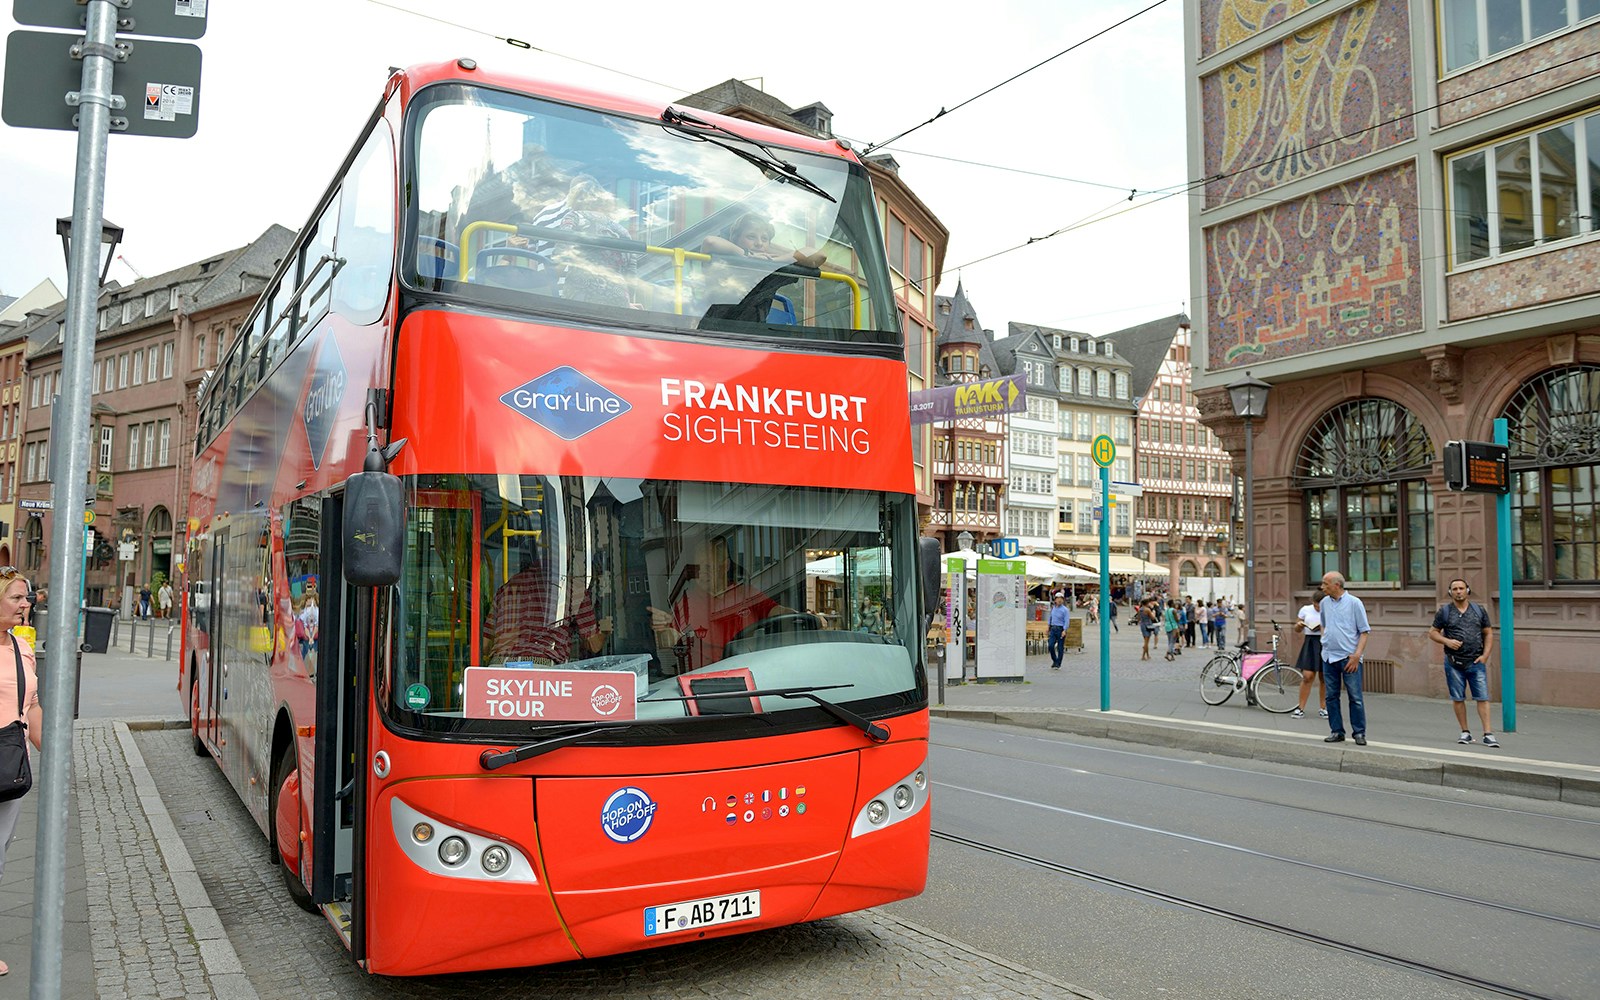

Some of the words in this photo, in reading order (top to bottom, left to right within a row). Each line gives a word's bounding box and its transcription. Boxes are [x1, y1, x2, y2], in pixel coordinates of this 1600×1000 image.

[513, 390, 572, 411] Gray
[575, 392, 620, 414] Line
[660, 377, 867, 423] FRANKFURT
[955, 403, 1004, 416] TAUNUSTURM
[662, 412, 871, 455] SIGHTSEEING
[1099, 441, 1110, 460] H
[21, 500, 36, 508] Neue
[993, 543, 1001, 557] U
[1004, 542, 1017, 557] U
[486, 678, 573, 697] SKYLINE
[590, 692, 615, 704] HOP-ON
[596, 696, 623, 707] HOP-OFF
[486, 700, 545, 717] TOUR
[601, 799, 643, 825] HOP-ON
[611, 803, 656, 831] HOP-OFF
[648, 923, 654, 931] D
[664, 907, 677, 930] F
[691, 902, 715, 926] AB
[719, 895, 753, 920] 711
